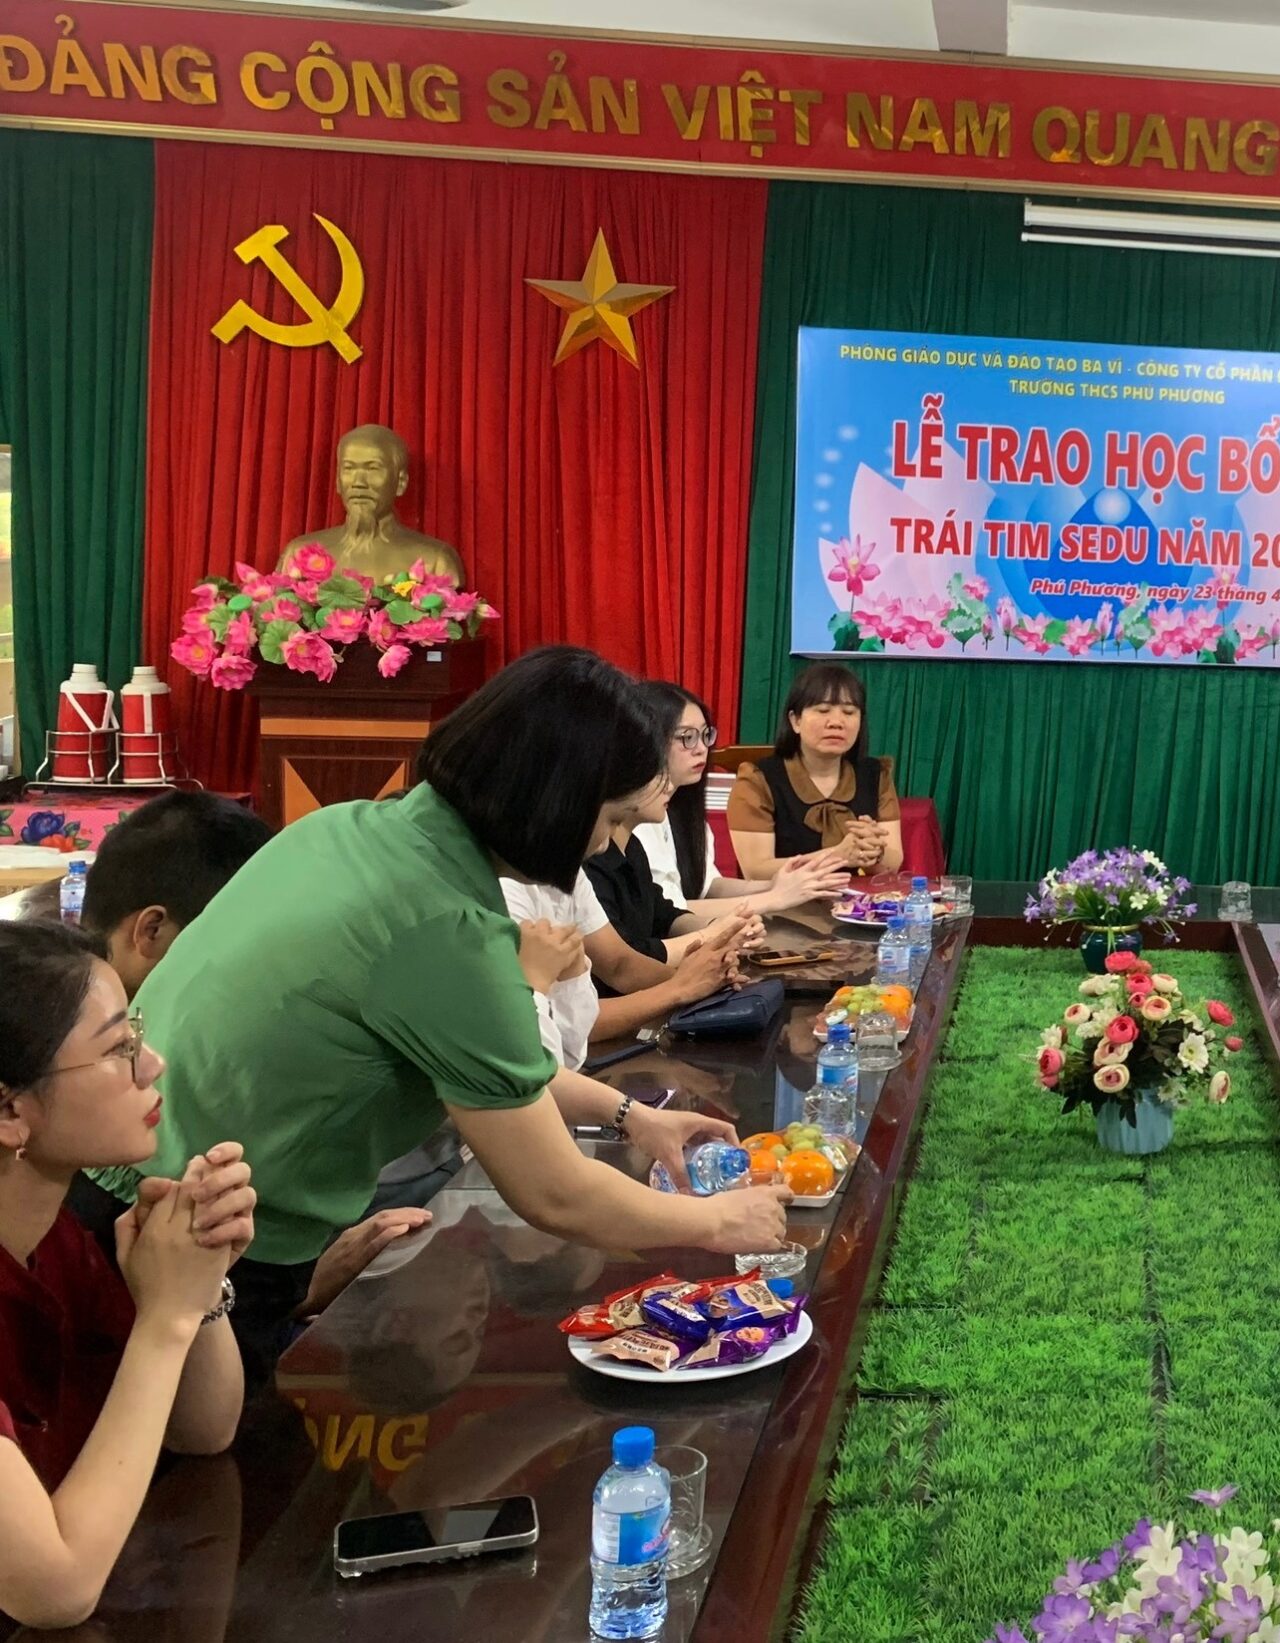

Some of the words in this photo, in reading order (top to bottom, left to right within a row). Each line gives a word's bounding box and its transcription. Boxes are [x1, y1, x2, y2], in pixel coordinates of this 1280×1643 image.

[0, 14, 217, 105] ĐẢNG
[240, 44, 460, 131] CỘNG
[487, 51, 640, 136] SẢN
[661, 69, 822, 158] VIỆT
[847, 91, 1011, 159] NAM
[1032, 106, 1279, 177] QUANG
[945, 351, 977, 369] DỤC
[1045, 356, 1078, 374] TẠO
[1082, 359, 1102, 374] BA
[1136, 360, 1179, 378] CÔNG
[1183, 364, 1202, 379] TY
[1079, 382, 1119, 399] THCS
[1159, 388, 1226, 405] PHƯƠNG
[893, 394, 944, 479] LỄ
[958, 425, 1092, 487] TRAO
[1105, 431, 1205, 505] HỌC
[890, 508, 973, 559] TRÁI
[984, 521, 1050, 559] TIM
[1059, 524, 1149, 564] SEDU
[1158, 518, 1242, 566] NĂM
[1030, 578, 1065, 595] Phú
[1069, 580, 1141, 600] Phương,
[1146, 585, 1190, 602] ngày
[1193, 586, 1213, 600] 23
[1217, 584, 1266, 606] tháng
[1270, 588, 1280, 602] 4
